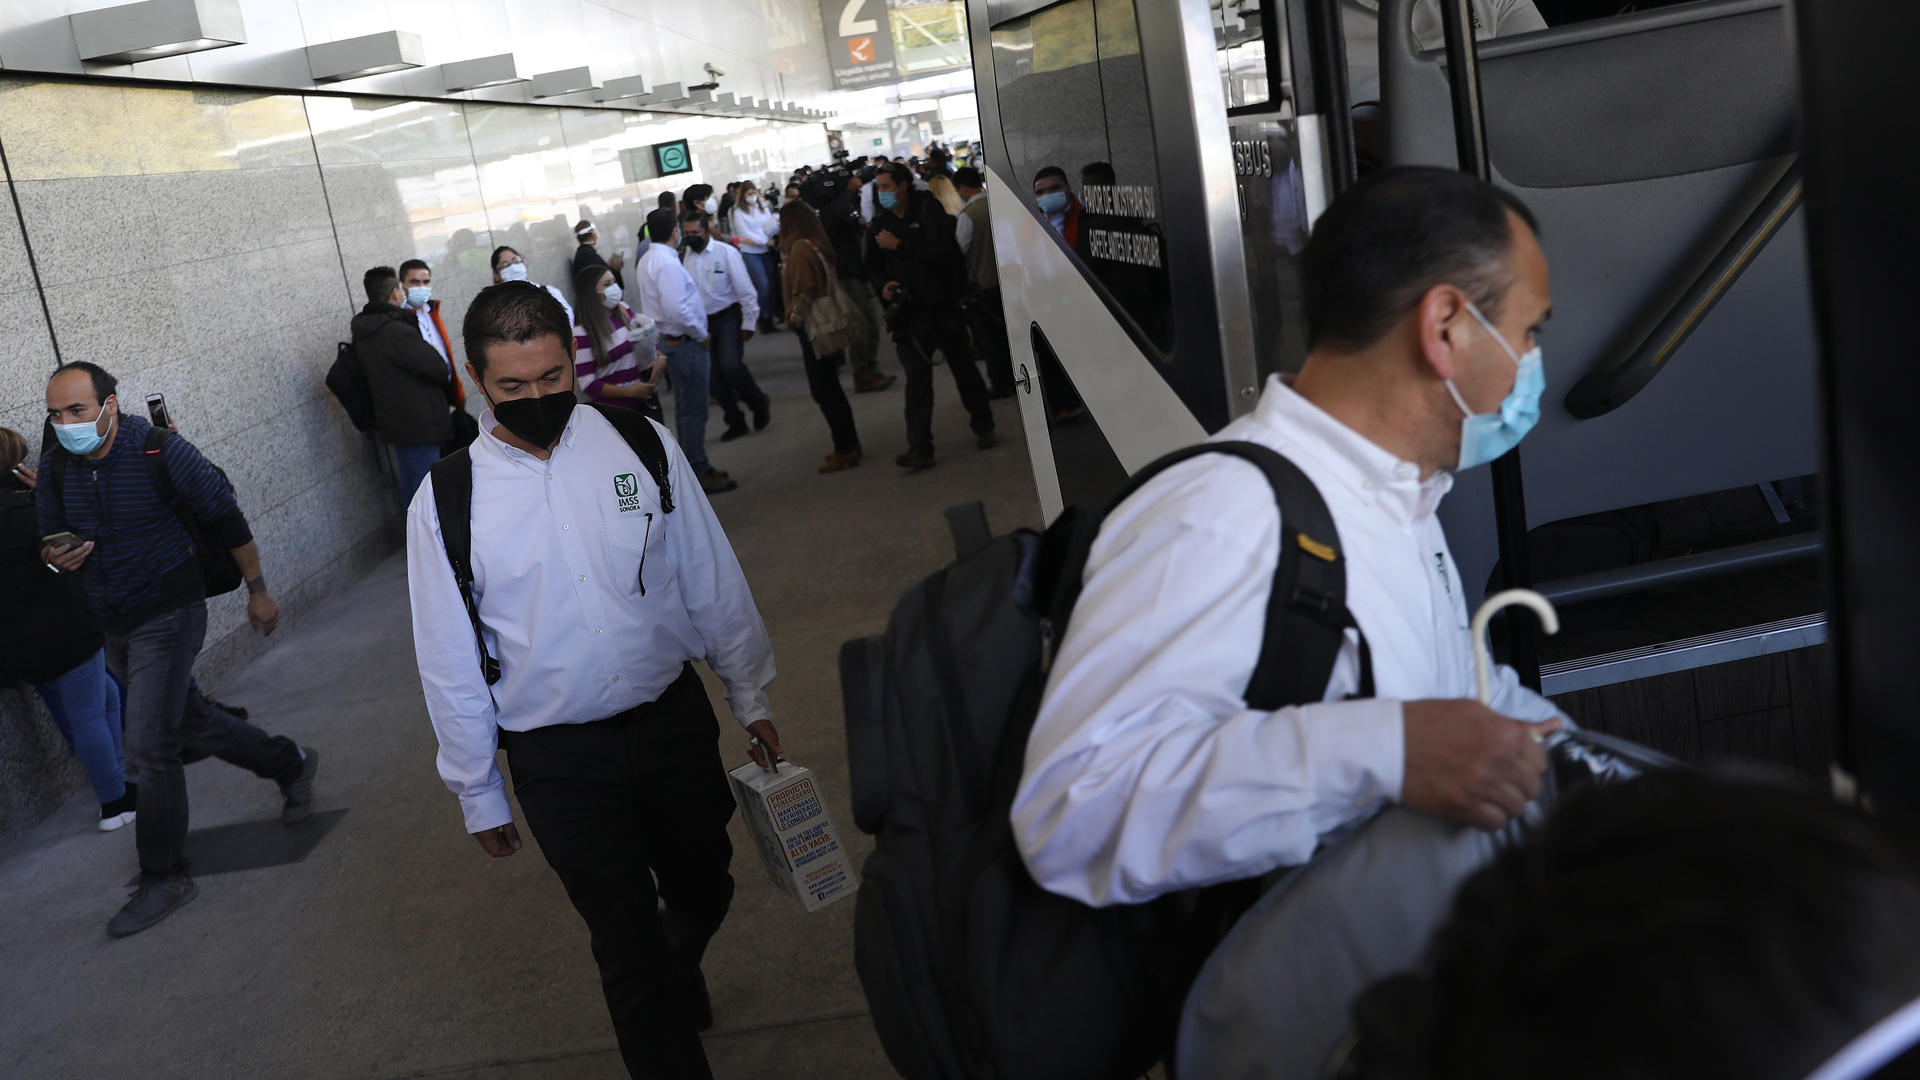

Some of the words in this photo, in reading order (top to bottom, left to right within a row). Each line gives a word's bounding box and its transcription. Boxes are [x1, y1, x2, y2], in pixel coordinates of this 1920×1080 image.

[839, 0, 878, 37] 2
[891, 118, 910, 144] 2
[1084, 185, 1104, 214] FAVOR
[1103, 185, 1114, 215] DE
[1112, 185, 1145, 218] MOSTRAR
[1144, 186, 1155, 218] SU
[1089, 228, 1110, 259] GAFETE
[1108, 231, 1125, 262] ANTES
[1124, 232, 1133, 264] DE
[1132, 234, 1162, 268] ABORDAR
[619, 496, 639, 506] IMSS
[770, 781, 809, 804] PRODUCTO
[773, 788, 812, 810] PERECEDERO
[780, 802, 818, 823] REFRIGERADO
[787, 808, 820, 826] CONGELADO
[786, 836, 797, 844] VIDA
[813, 821, 828, 832] CORTES
[790, 844, 808, 858] ALTO
